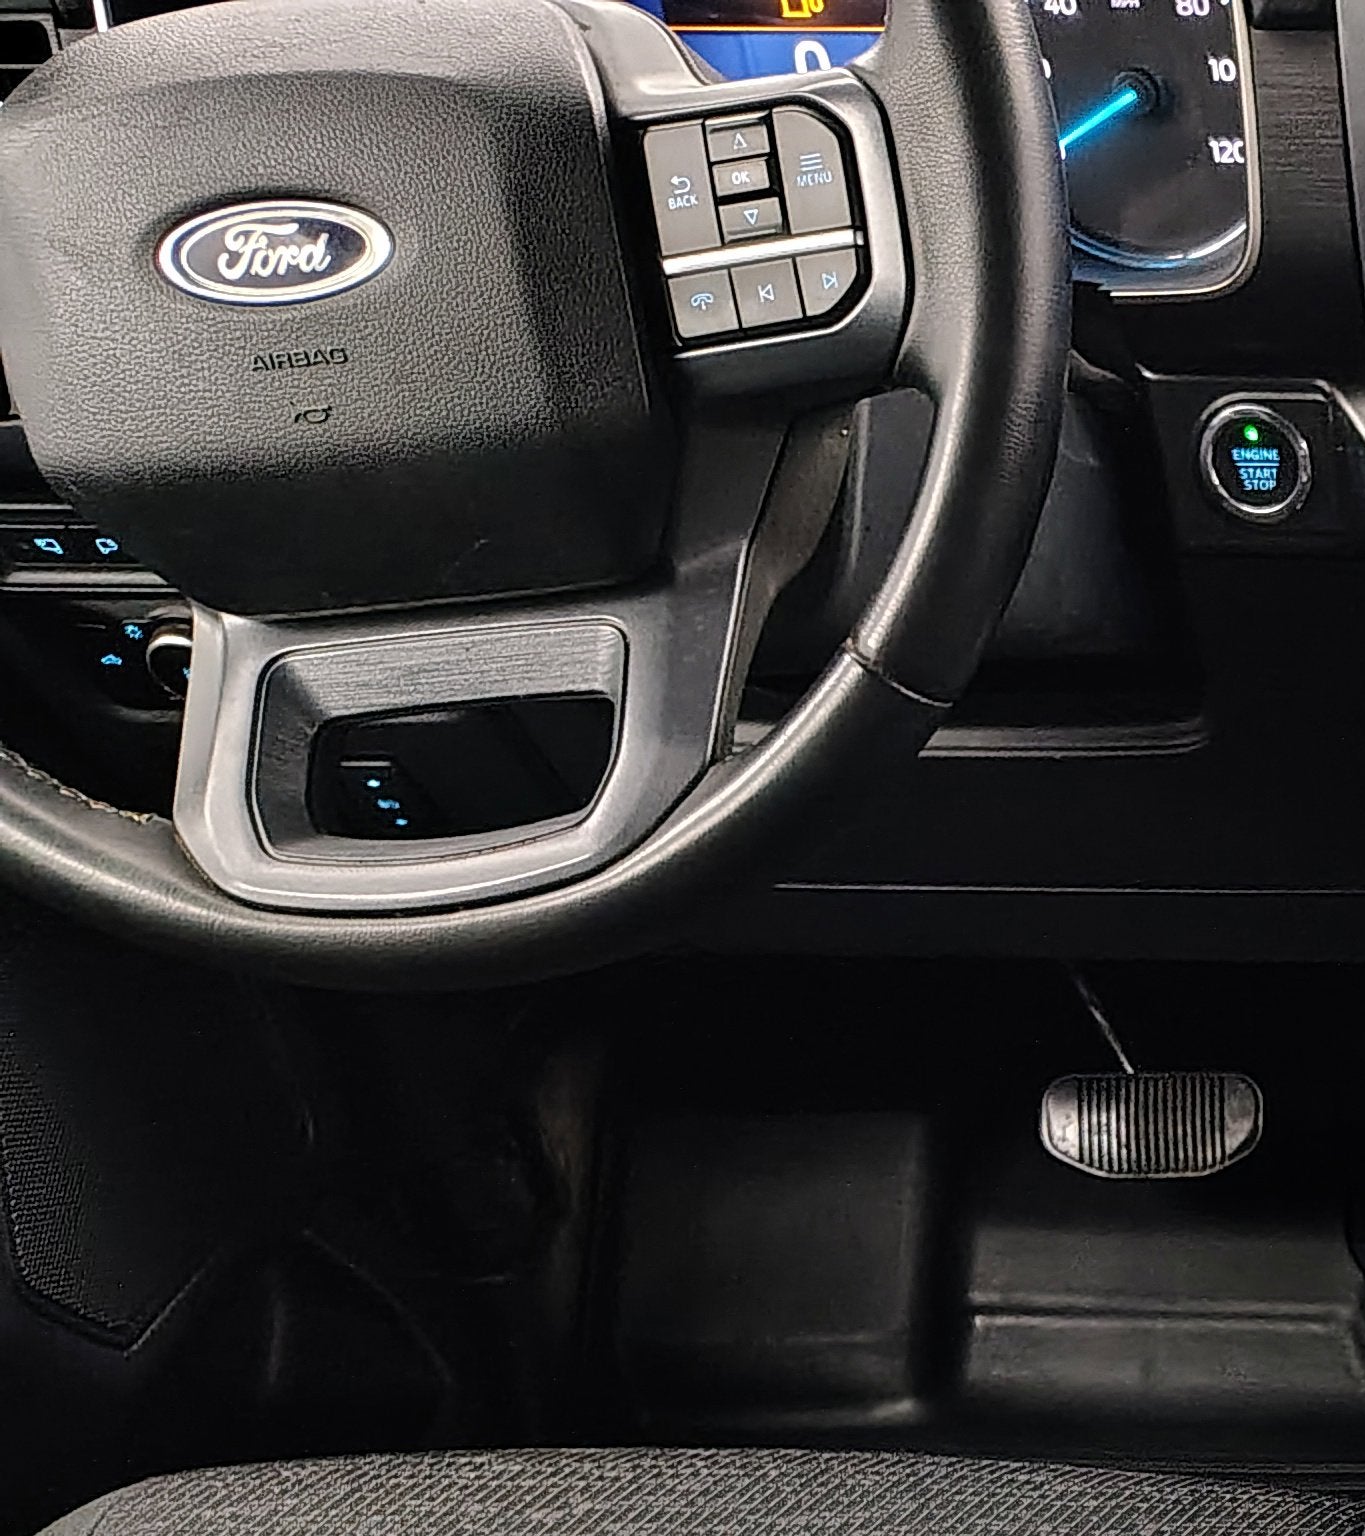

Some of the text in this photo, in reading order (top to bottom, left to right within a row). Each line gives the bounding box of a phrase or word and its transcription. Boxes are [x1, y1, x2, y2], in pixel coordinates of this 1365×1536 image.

[731, 172, 750, 185] OK
[796, 170, 833, 187] MENU
[668, 194, 699, 210] BACK
[217, 222, 332, 280] Ford
[252, 348, 348, 371] AIRBAG
[1231, 448, 1280, 461] ENGINE
[1239, 468, 1278, 480] START
[1243, 480, 1277, 491] STOP
